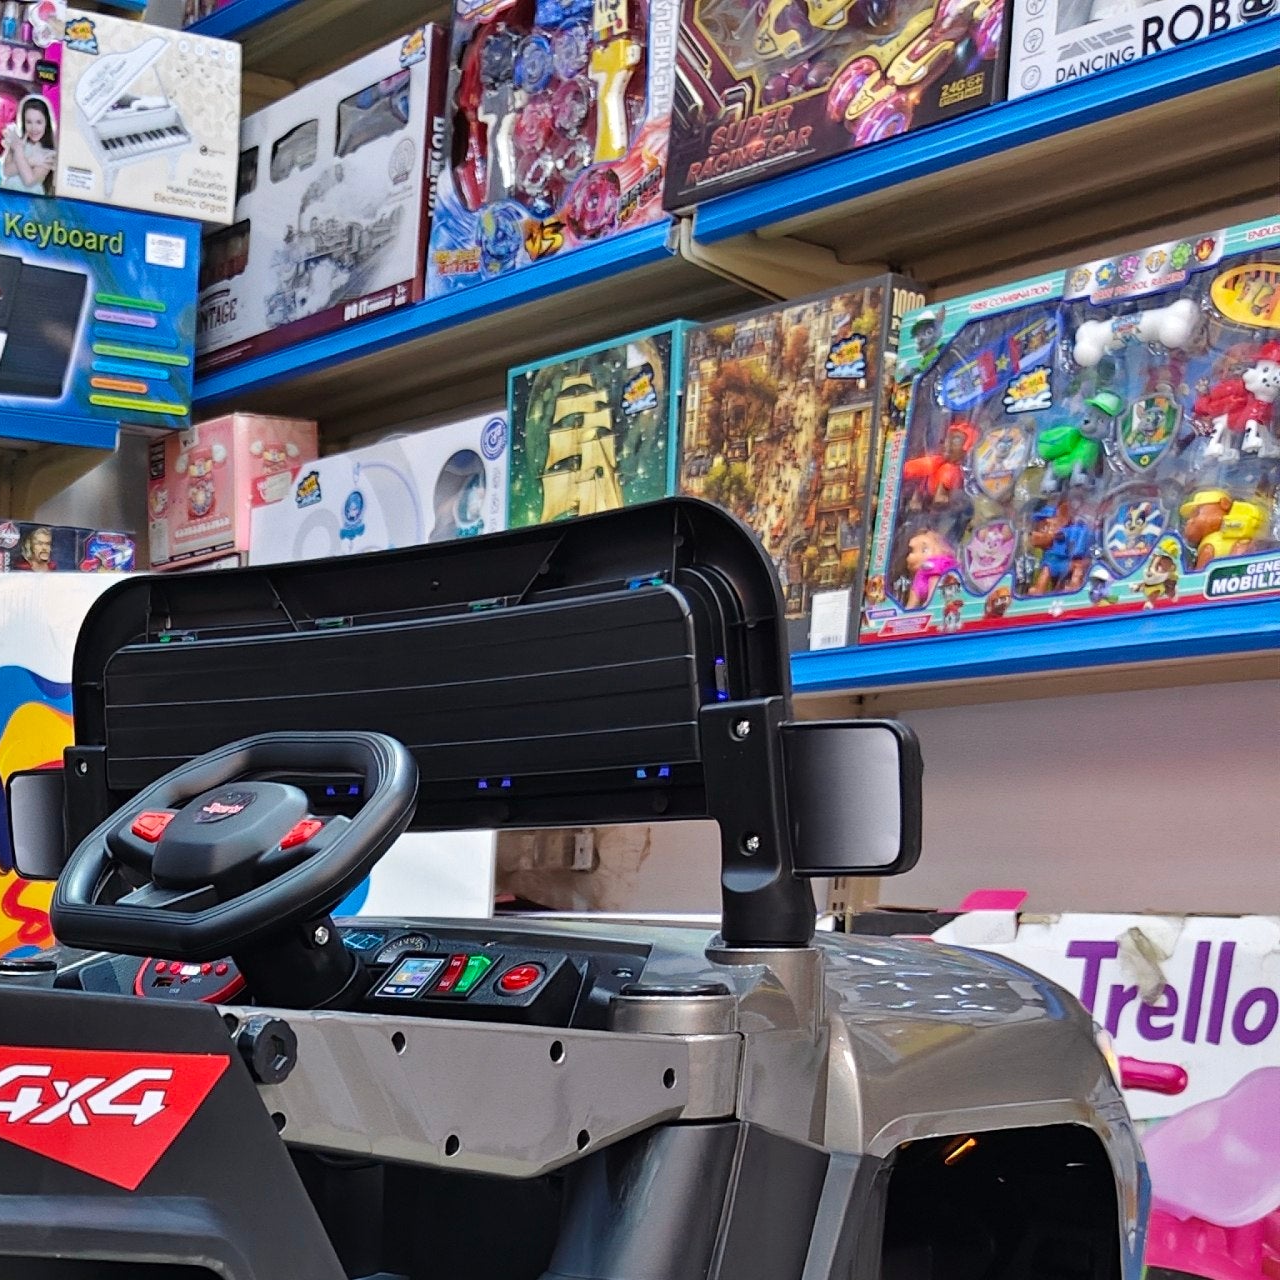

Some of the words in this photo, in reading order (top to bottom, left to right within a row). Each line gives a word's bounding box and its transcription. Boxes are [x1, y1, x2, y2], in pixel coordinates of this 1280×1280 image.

[1056, 46, 1135, 83] DANCING
[708, 104, 793, 154] SUPER
[686, 139, 766, 185] RACING
[768, 125, 813, 154] CAR
[3, 212, 124, 256] Keyboard
[1067, 940, 1280, 1046] Trello
